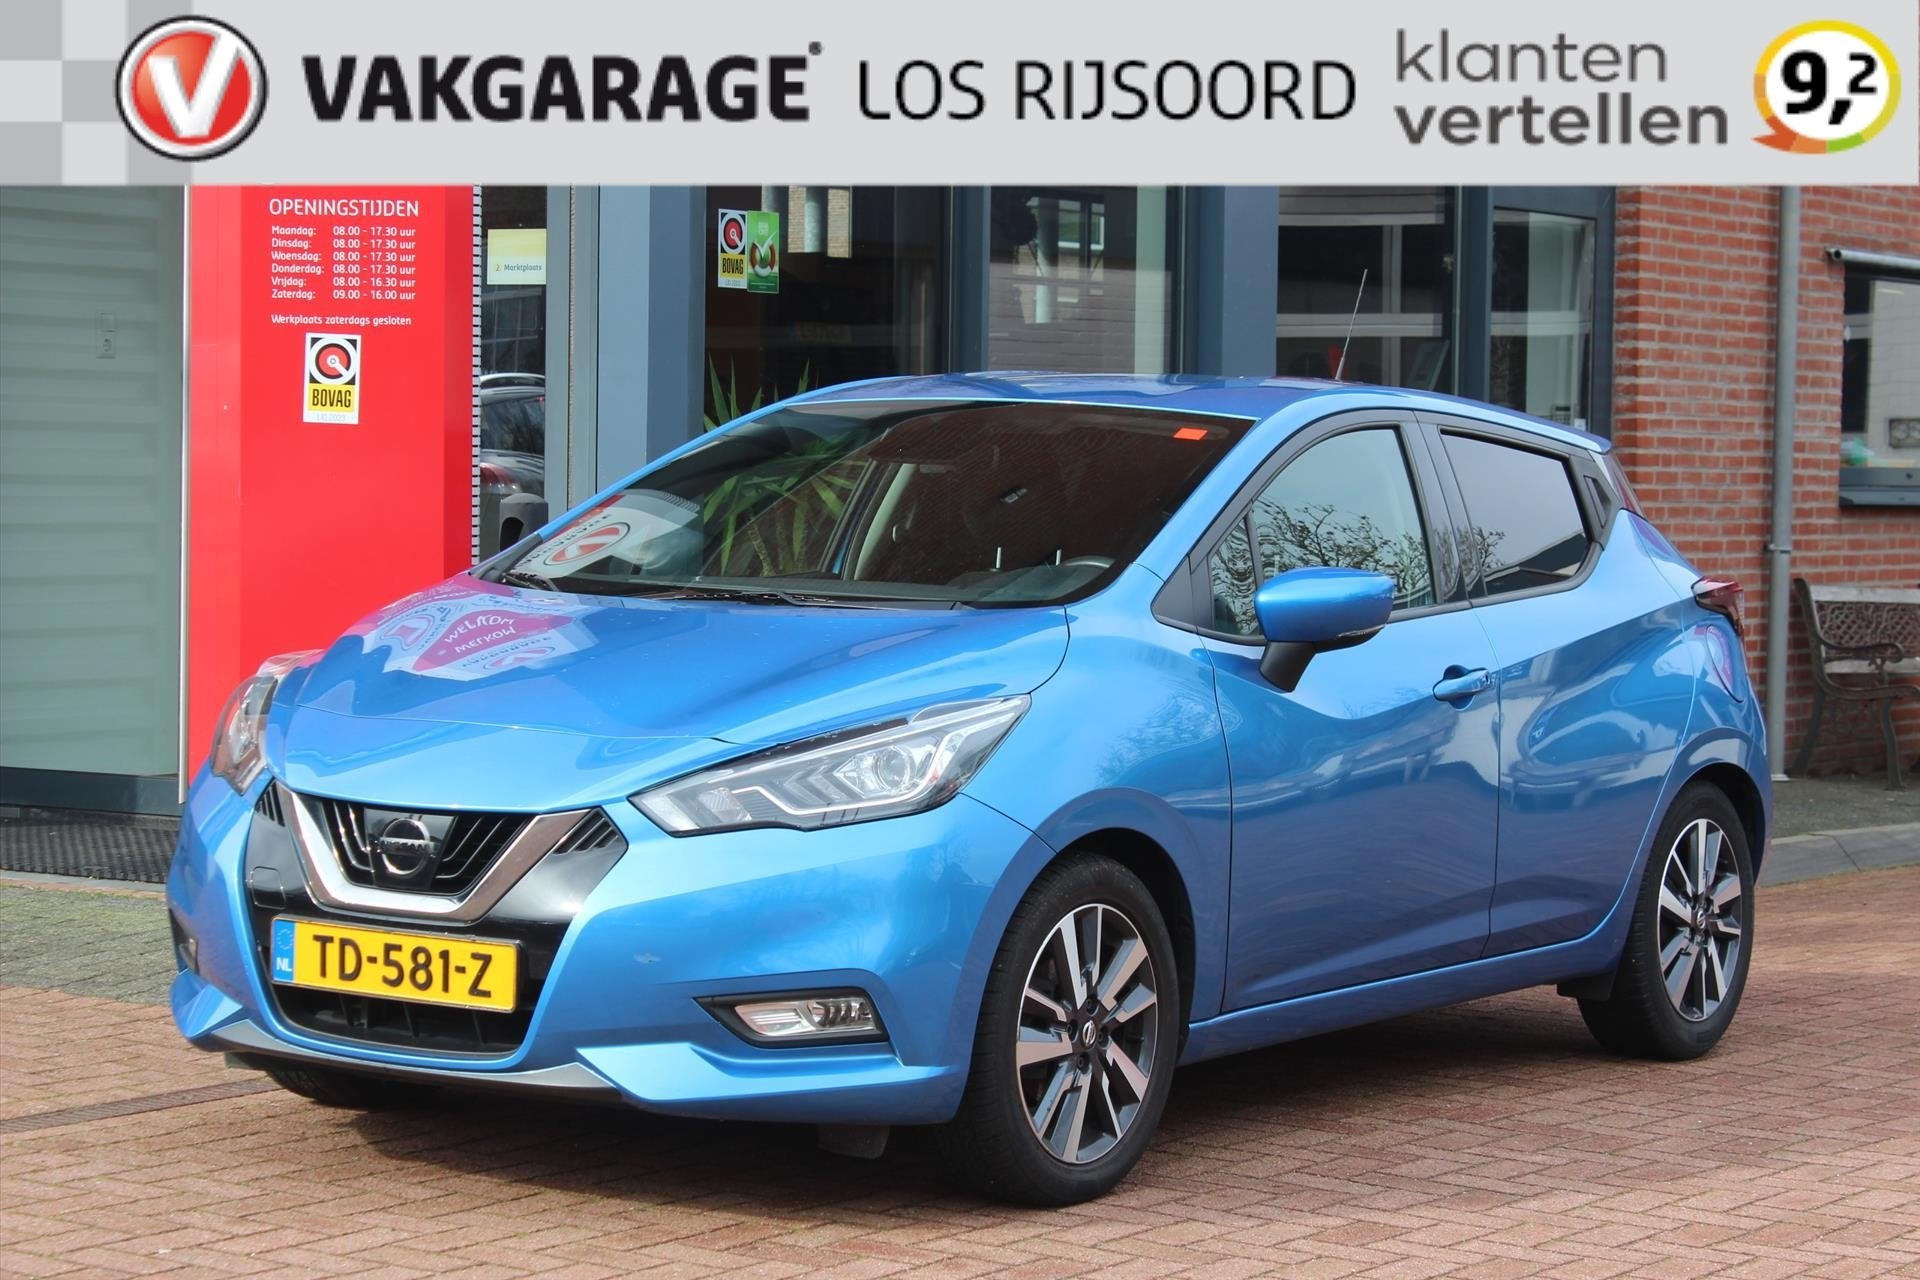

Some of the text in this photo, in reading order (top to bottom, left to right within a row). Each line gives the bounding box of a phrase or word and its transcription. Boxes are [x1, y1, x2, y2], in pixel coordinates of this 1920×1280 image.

[269, 198, 419, 216] OPENINGSTIJDEN
[271, 226, 316, 236] Maandag:
[333, 226, 360, 236] 08.00
[370, 226, 397, 236] 17.30
[400, 229, 416, 237] uur
[271, 238, 311, 249] Dinsdag:
[333, 239, 360, 248] 08.00
[370, 239, 397, 249] 17.30
[400, 242, 416, 250] uur
[271, 251, 321, 262] Woensdag:
[333, 252, 360, 261] 08.00
[370, 252, 397, 262] 17.30
[400, 254, 416, 262] uur
[271, 264, 324, 274] Donderdag:
[333, 264, 360, 274] 08.00
[370, 265, 397, 275] 17.30
[400, 267, 416, 275] uur
[721, 257, 744, 275] BOVAG
[271, 276, 306, 287] Vrijdag:
[333, 277, 360, 286] 08.00
[370, 278, 397, 288] 16.30
[400, 280, 416, 288] uur
[271, 289, 316, 300] Zaterdag:
[333, 290, 360, 299] 09.00
[370, 290, 397, 300] 16.00
[400, 293, 416, 301] uur
[271, 314, 411, 327] Werkplaats zaterdags gesloten
[312, 388, 352, 408] BOVAG
[276, 957, 293, 971] NL
[312, 933, 493, 999] TD-581-Z
